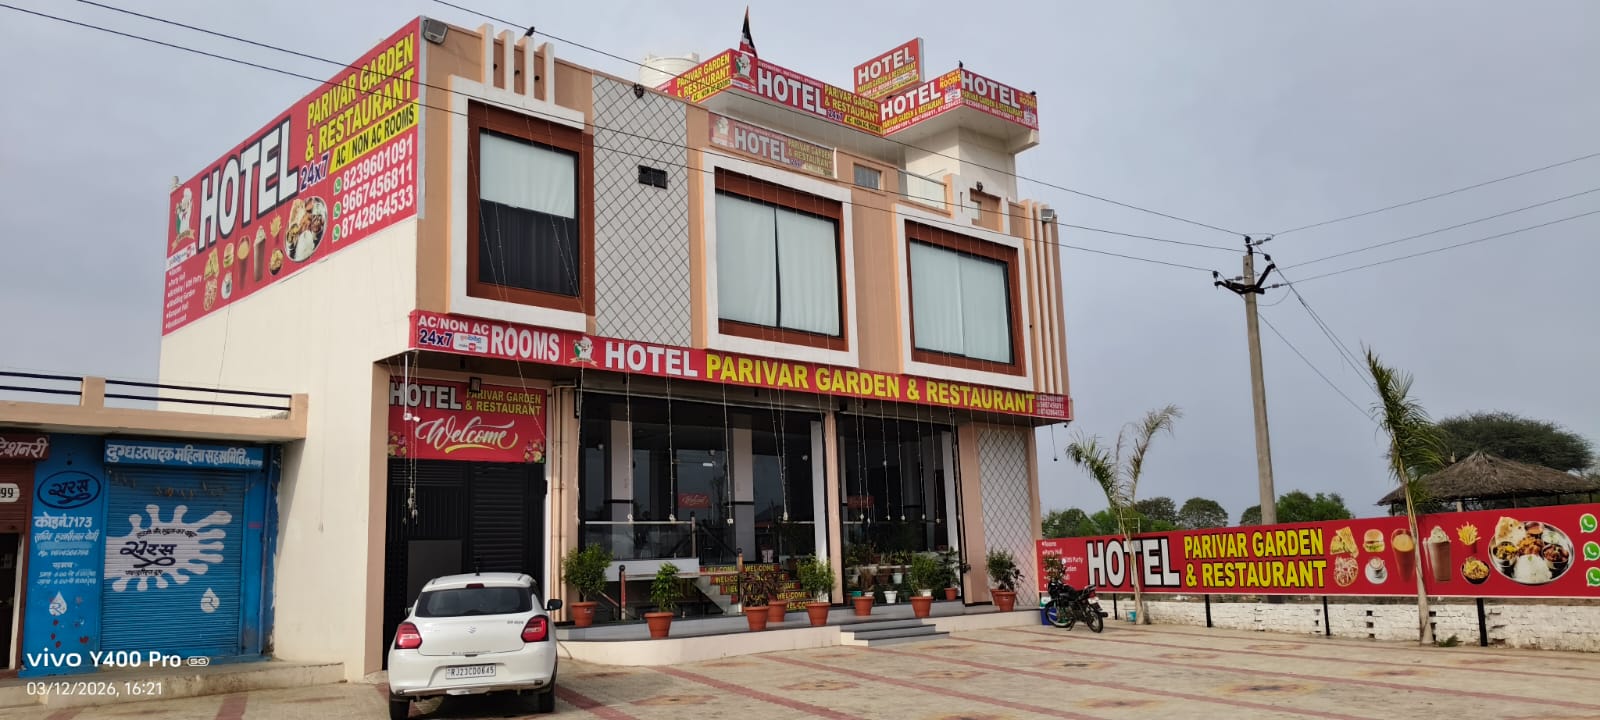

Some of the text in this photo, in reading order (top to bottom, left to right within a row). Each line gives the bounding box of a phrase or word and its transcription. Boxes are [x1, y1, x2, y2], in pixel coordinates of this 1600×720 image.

[306, 32, 414, 130] PARIVAR GARDEN
[684, 66, 730, 96] RESTAURANT
[704, 52, 730, 74] GARDEN
[858, 47, 914, 86] HOTEL
[758, 68, 826, 116] HOTEL
[825, 83, 851, 102] PARIVAR
[881, 82, 941, 120] HOTEL
[961, 70, 1020, 108] HOTEL
[305, 67, 414, 162] & RESTAURANT
[832, 98, 879, 123] RESTAURANT
[336, 145, 346, 168] AC
[352, 133, 369, 158] NON
[371, 124, 382, 147] AC
[384, 104, 414, 139] ROOMS
[735, 127, 790, 164] HOTEL
[300, 150, 330, 193] 24x7
[343, 134, 414, 191] 8239601091
[198, 116, 299, 253] HOTEL
[342, 158, 413, 214] 9667456811
[342, 184, 414, 239] 8742864533
[418, 315, 489, 335] AC/NON AC
[419, 329, 453, 347] 24x7
[491, 325, 560, 362] ROOMS
[390, 382, 462, 410] HOTEL
[506, 391, 541, 405] GARDEN
[605, 340, 1036, 415] HOTEL PARIVAR GARDEN & RESTAURANT
[465, 400, 541, 417] & RESTAURANT
[415, 416, 518, 450] Welcome
[175, 444, 205, 464] महिला
[120, 540, 177, 568] सरस
[1086, 536, 1181, 588] HOTEL
[1184, 528, 1324, 559] PARIVAR GARDEN
[1185, 560, 1327, 588] & RESTAURANT
